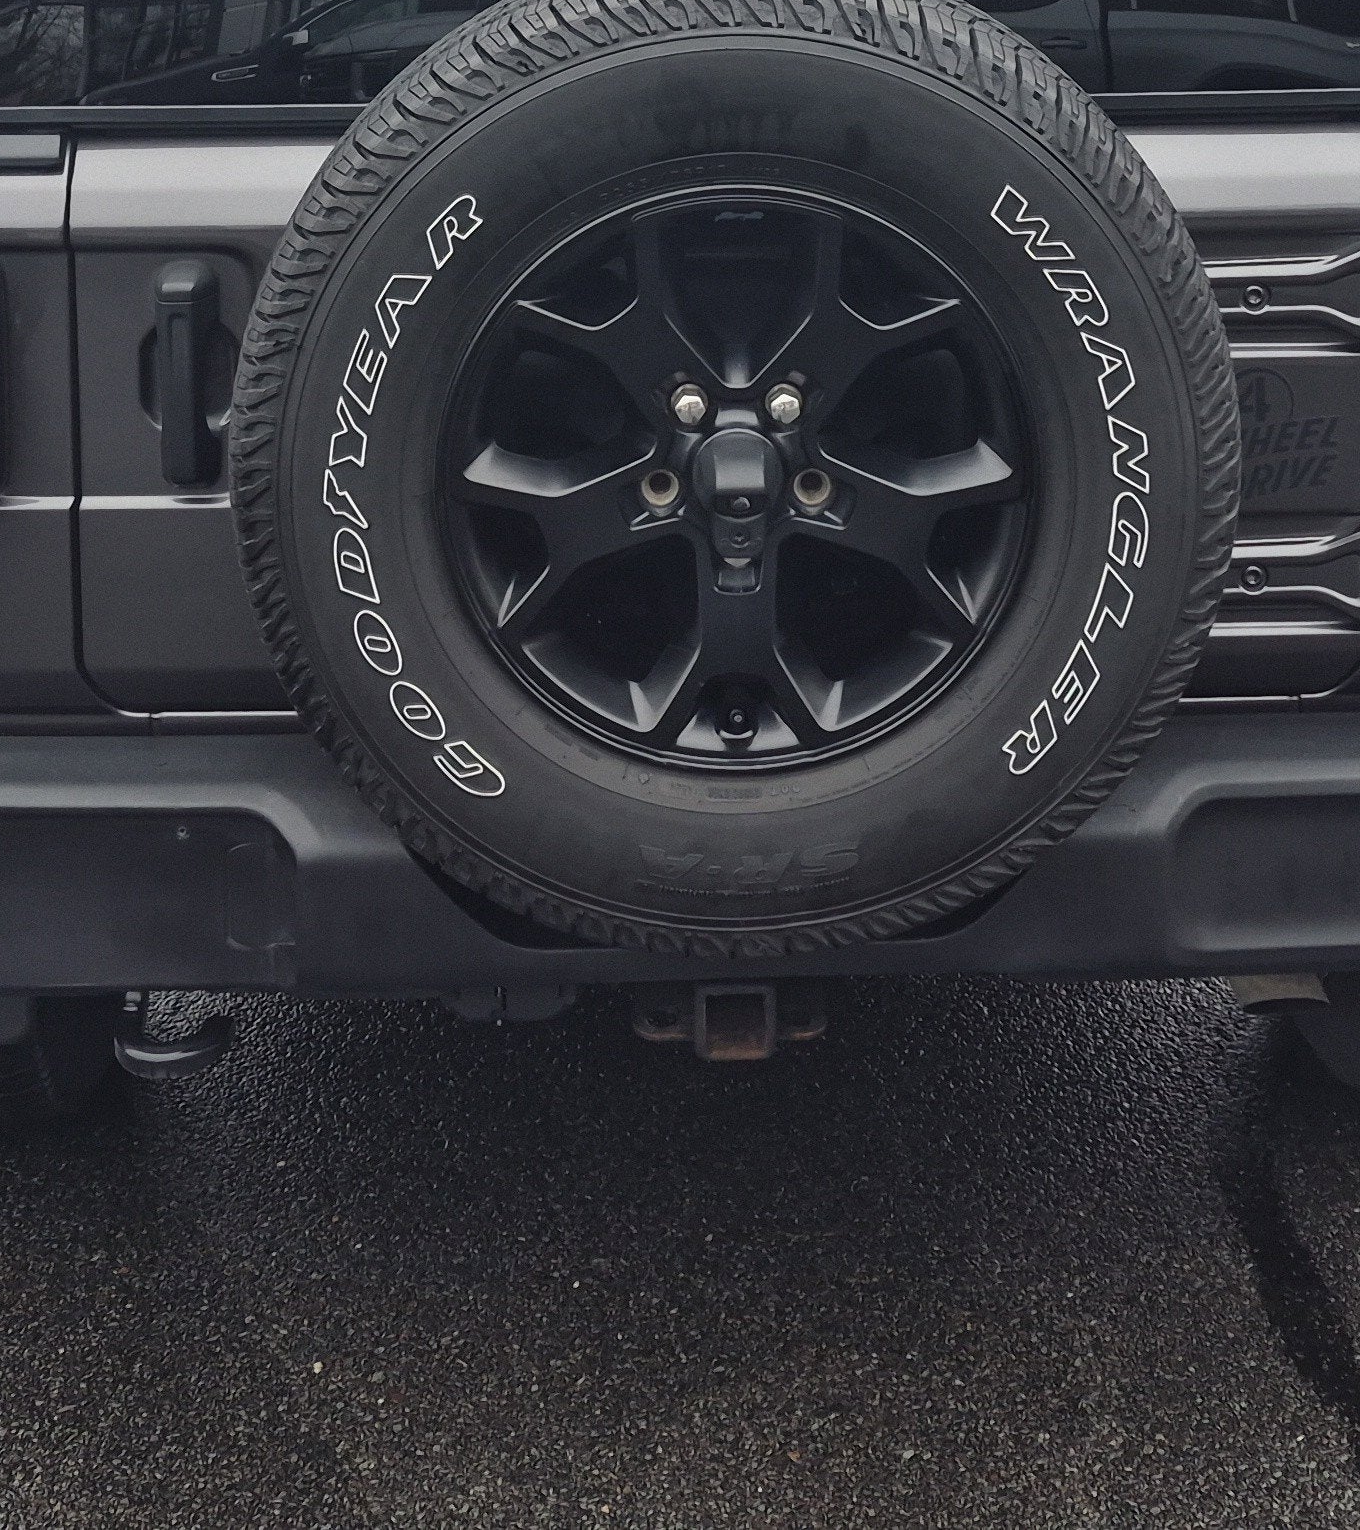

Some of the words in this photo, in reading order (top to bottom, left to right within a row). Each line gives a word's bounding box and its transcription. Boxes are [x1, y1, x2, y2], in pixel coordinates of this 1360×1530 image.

[322, 192, 507, 798] GOODYEAR
[989, 184, 1152, 776] WRANGLER
[1242, 416, 1340, 460] HEEL
[1242, 453, 1338, 500] RIVE
